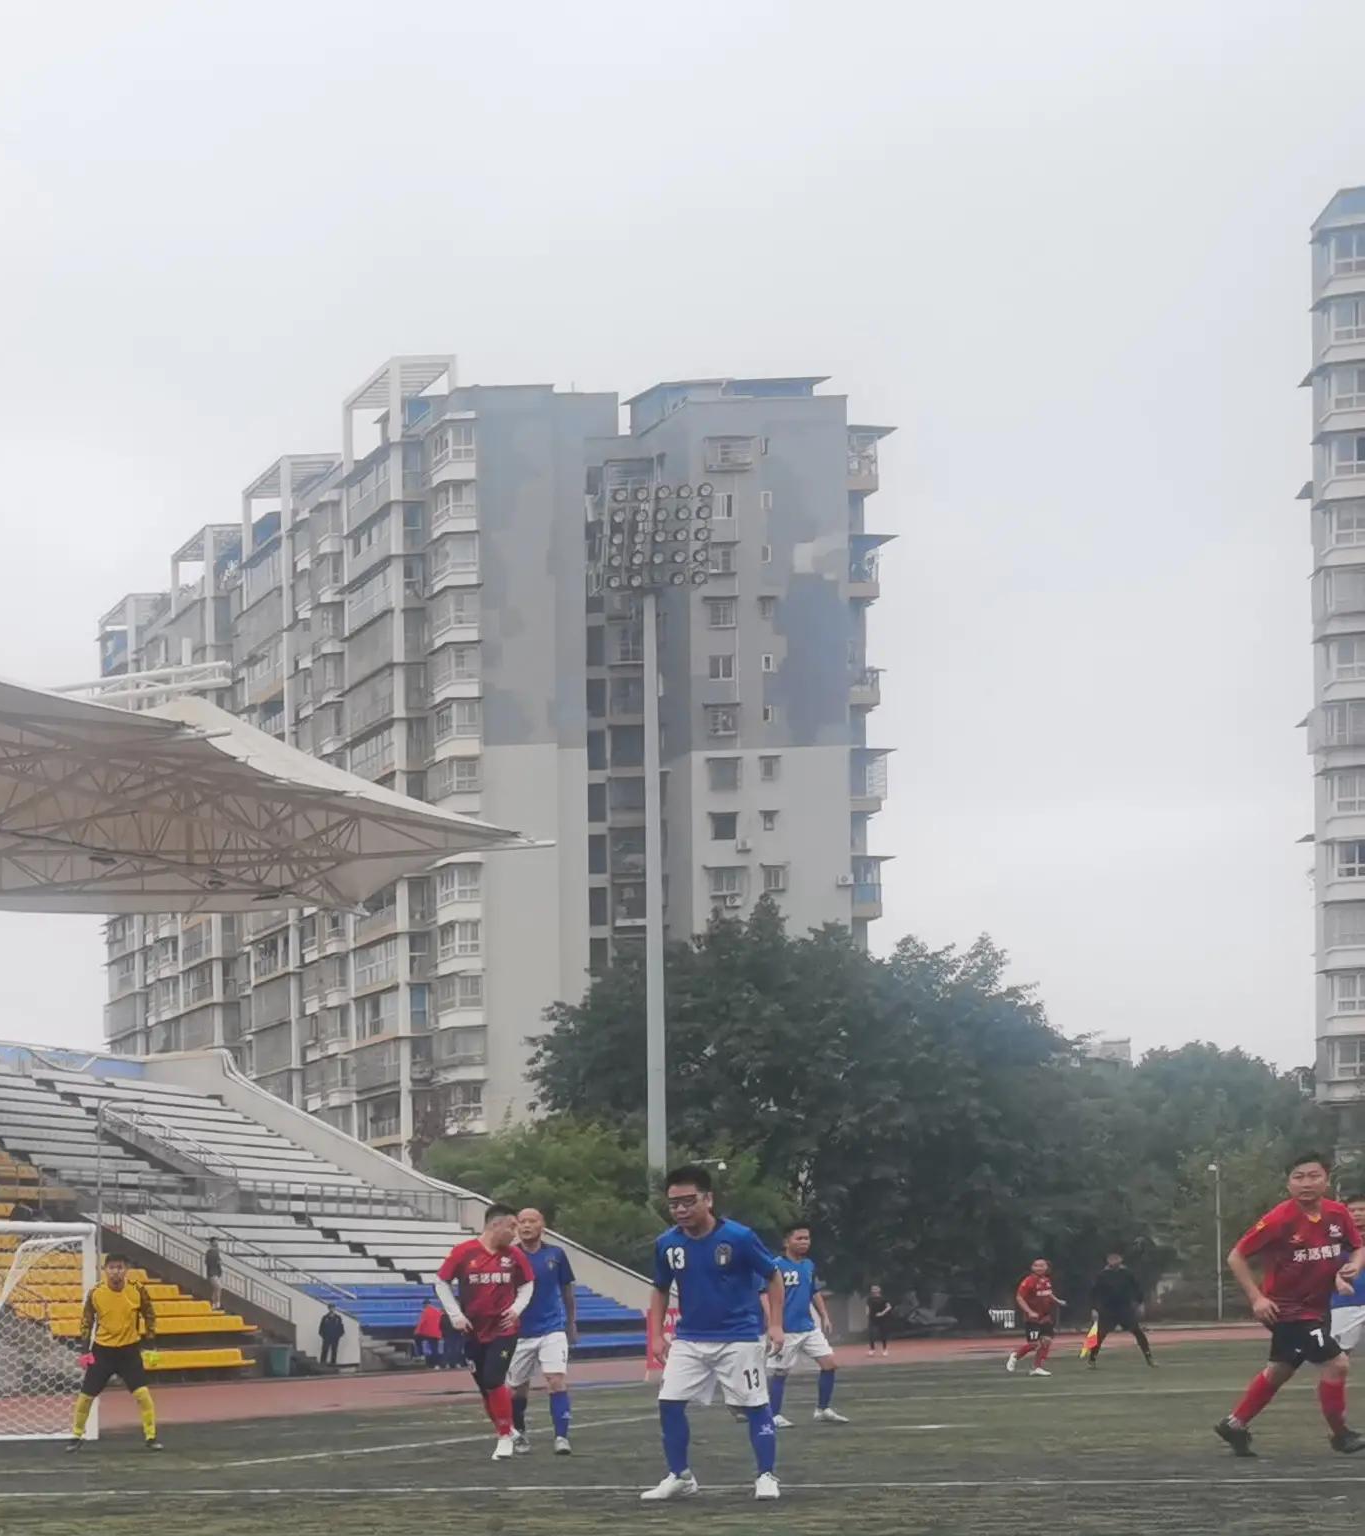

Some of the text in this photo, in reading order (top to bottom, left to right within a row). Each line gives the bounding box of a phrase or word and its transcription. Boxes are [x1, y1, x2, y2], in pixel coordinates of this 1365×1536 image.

[665, 1246, 686, 1270] 13
[782, 1270, 800, 1286] 22
[1309, 1327, 1325, 1348] 7
[742, 1367, 760, 1391] 13
